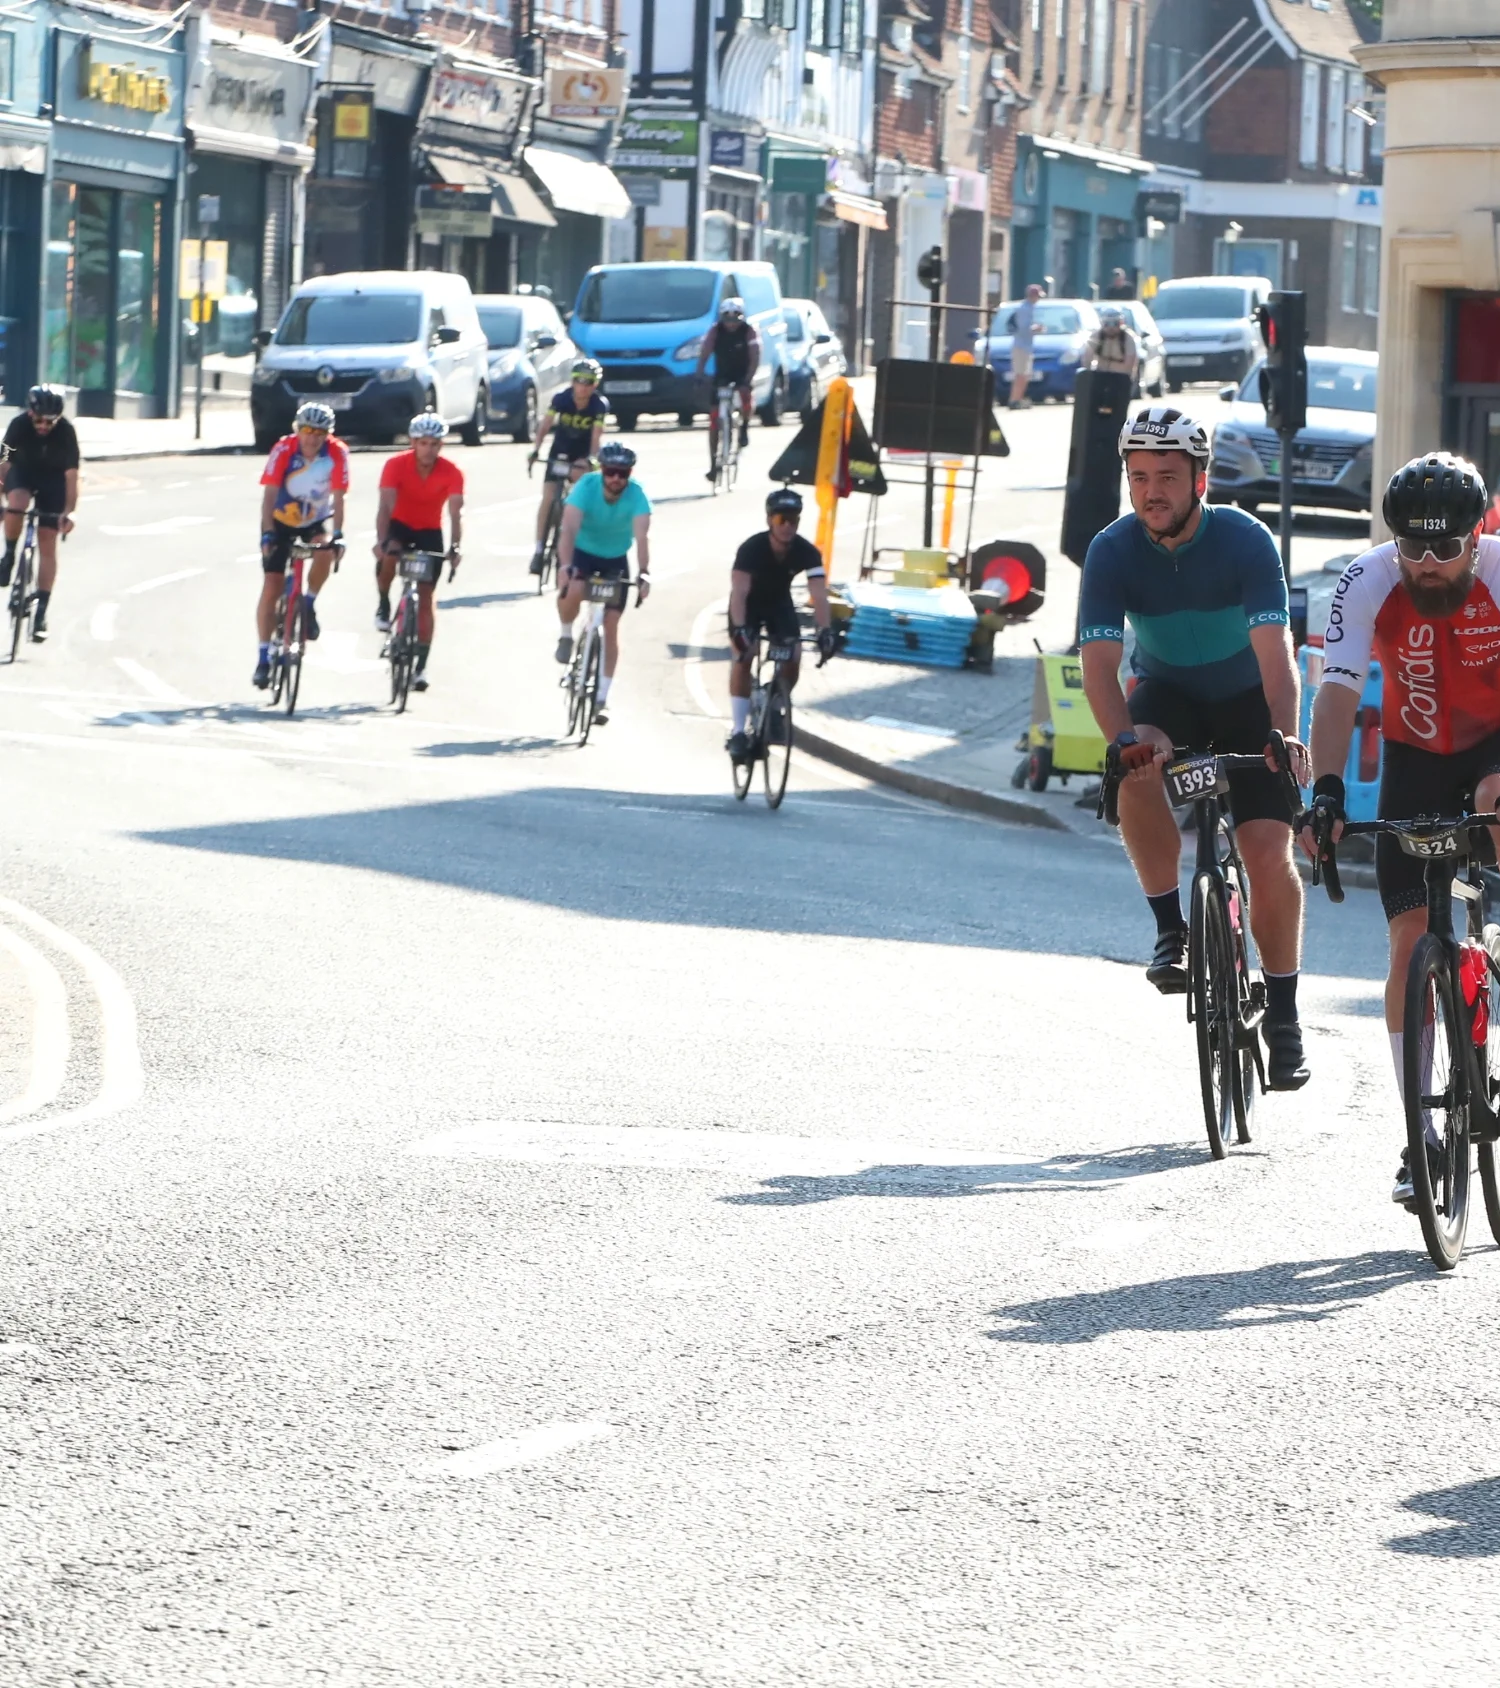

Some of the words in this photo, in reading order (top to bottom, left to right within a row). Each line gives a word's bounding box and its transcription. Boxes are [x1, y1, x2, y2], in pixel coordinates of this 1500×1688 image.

[1145, 423, 1166, 435] 1393
[1423, 518, 1447, 530] 1324
[1325, 563, 1364, 643] Cofidis
[1086, 628, 1102, 639] LE
[1461, 660, 1485, 668] VAN
[1323, 666, 1362, 681] OOK
[1397, 623, 1438, 740] Cofidis
[1172, 765, 1217, 796] 1393
[1408, 836, 1458, 855] 1324
